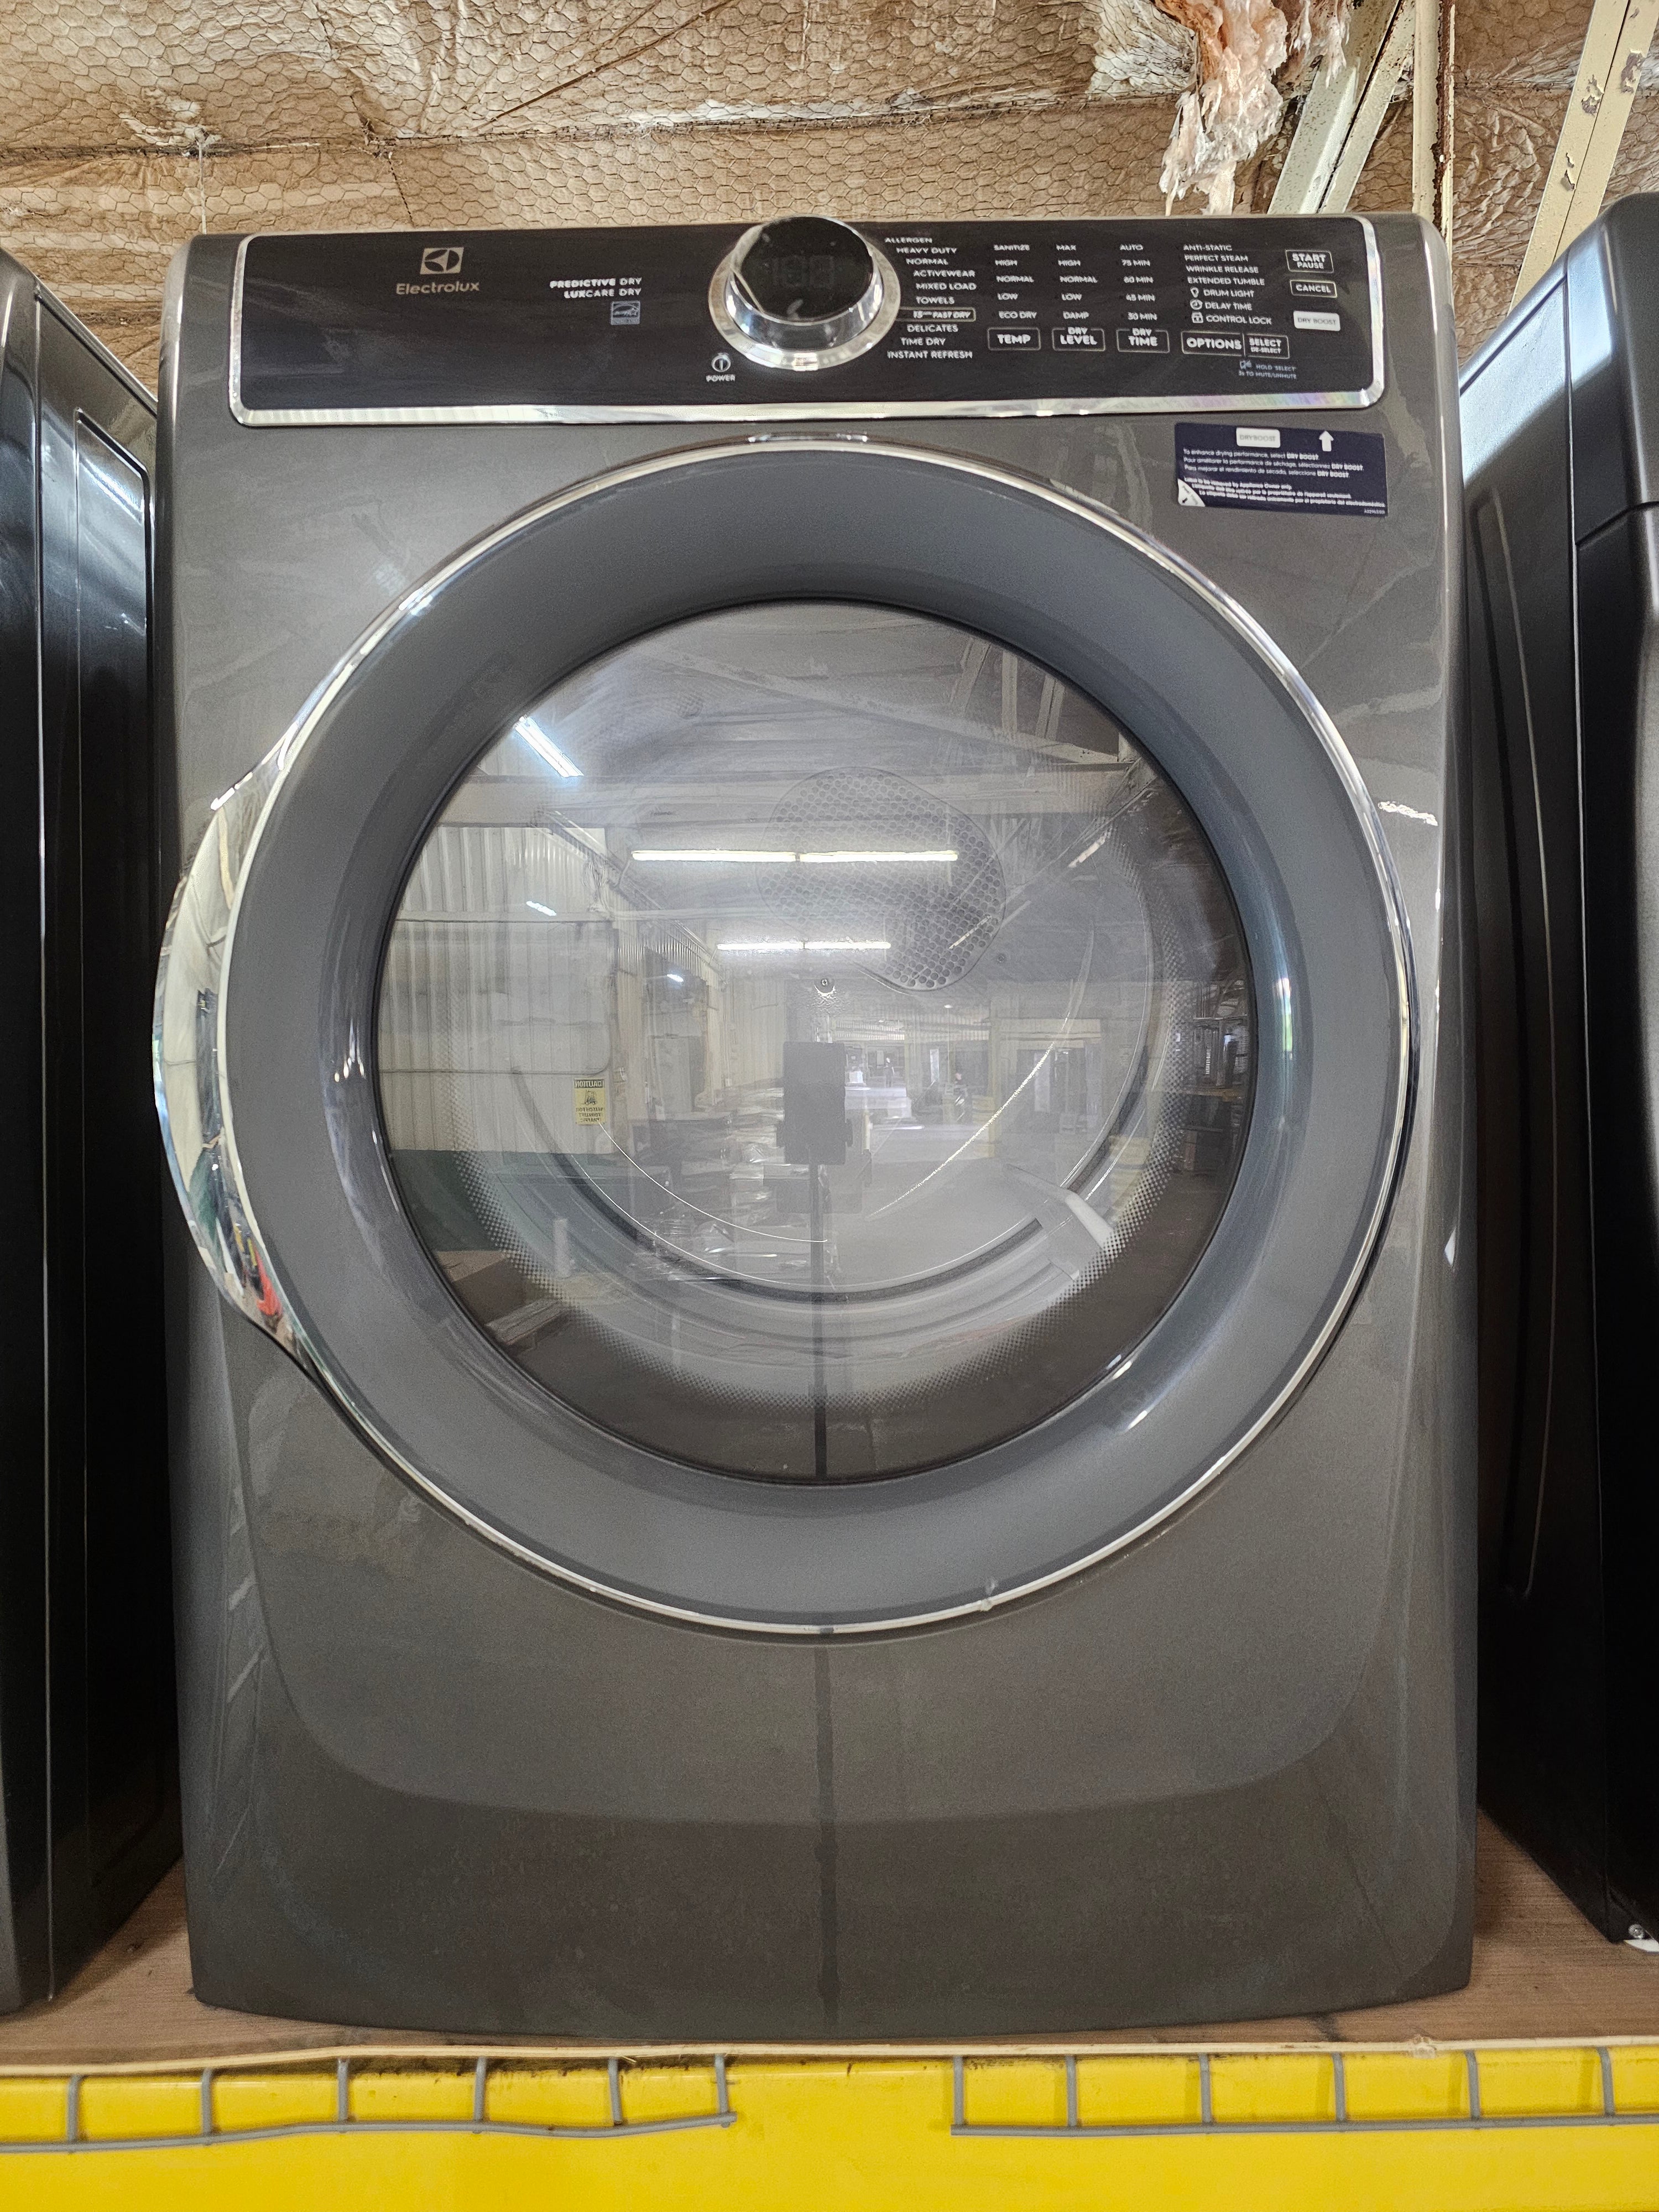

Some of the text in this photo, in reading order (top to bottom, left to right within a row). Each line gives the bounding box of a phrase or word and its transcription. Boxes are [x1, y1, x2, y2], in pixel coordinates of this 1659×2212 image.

[1292, 253, 1326, 262] START
[550, 277, 642, 289] PREDICTIVE DRY
[396, 281, 480, 295] Electrolux
[1296, 284, 1331, 293] CANCEL
[564, 288, 641, 299] LUXCARE DRY
[1230, 289, 1255, 298] LIGHT
[1233, 302, 1252, 311] TIME
[1063, 311, 1089, 319] DAMP
[1128, 312, 1138, 320] 30
[1206, 315, 1272, 325] CONTROL LOCK
[926, 337, 946, 346] DRY
[997, 334, 1031, 344] TEMP
[1060, 335, 1098, 345] LEVEL
[1128, 336, 1158, 346] TIME
[1187, 337, 1241, 349] OPTIONS
[1249, 338, 1281, 347] SELECT
[706, 374, 735, 382] POWER
